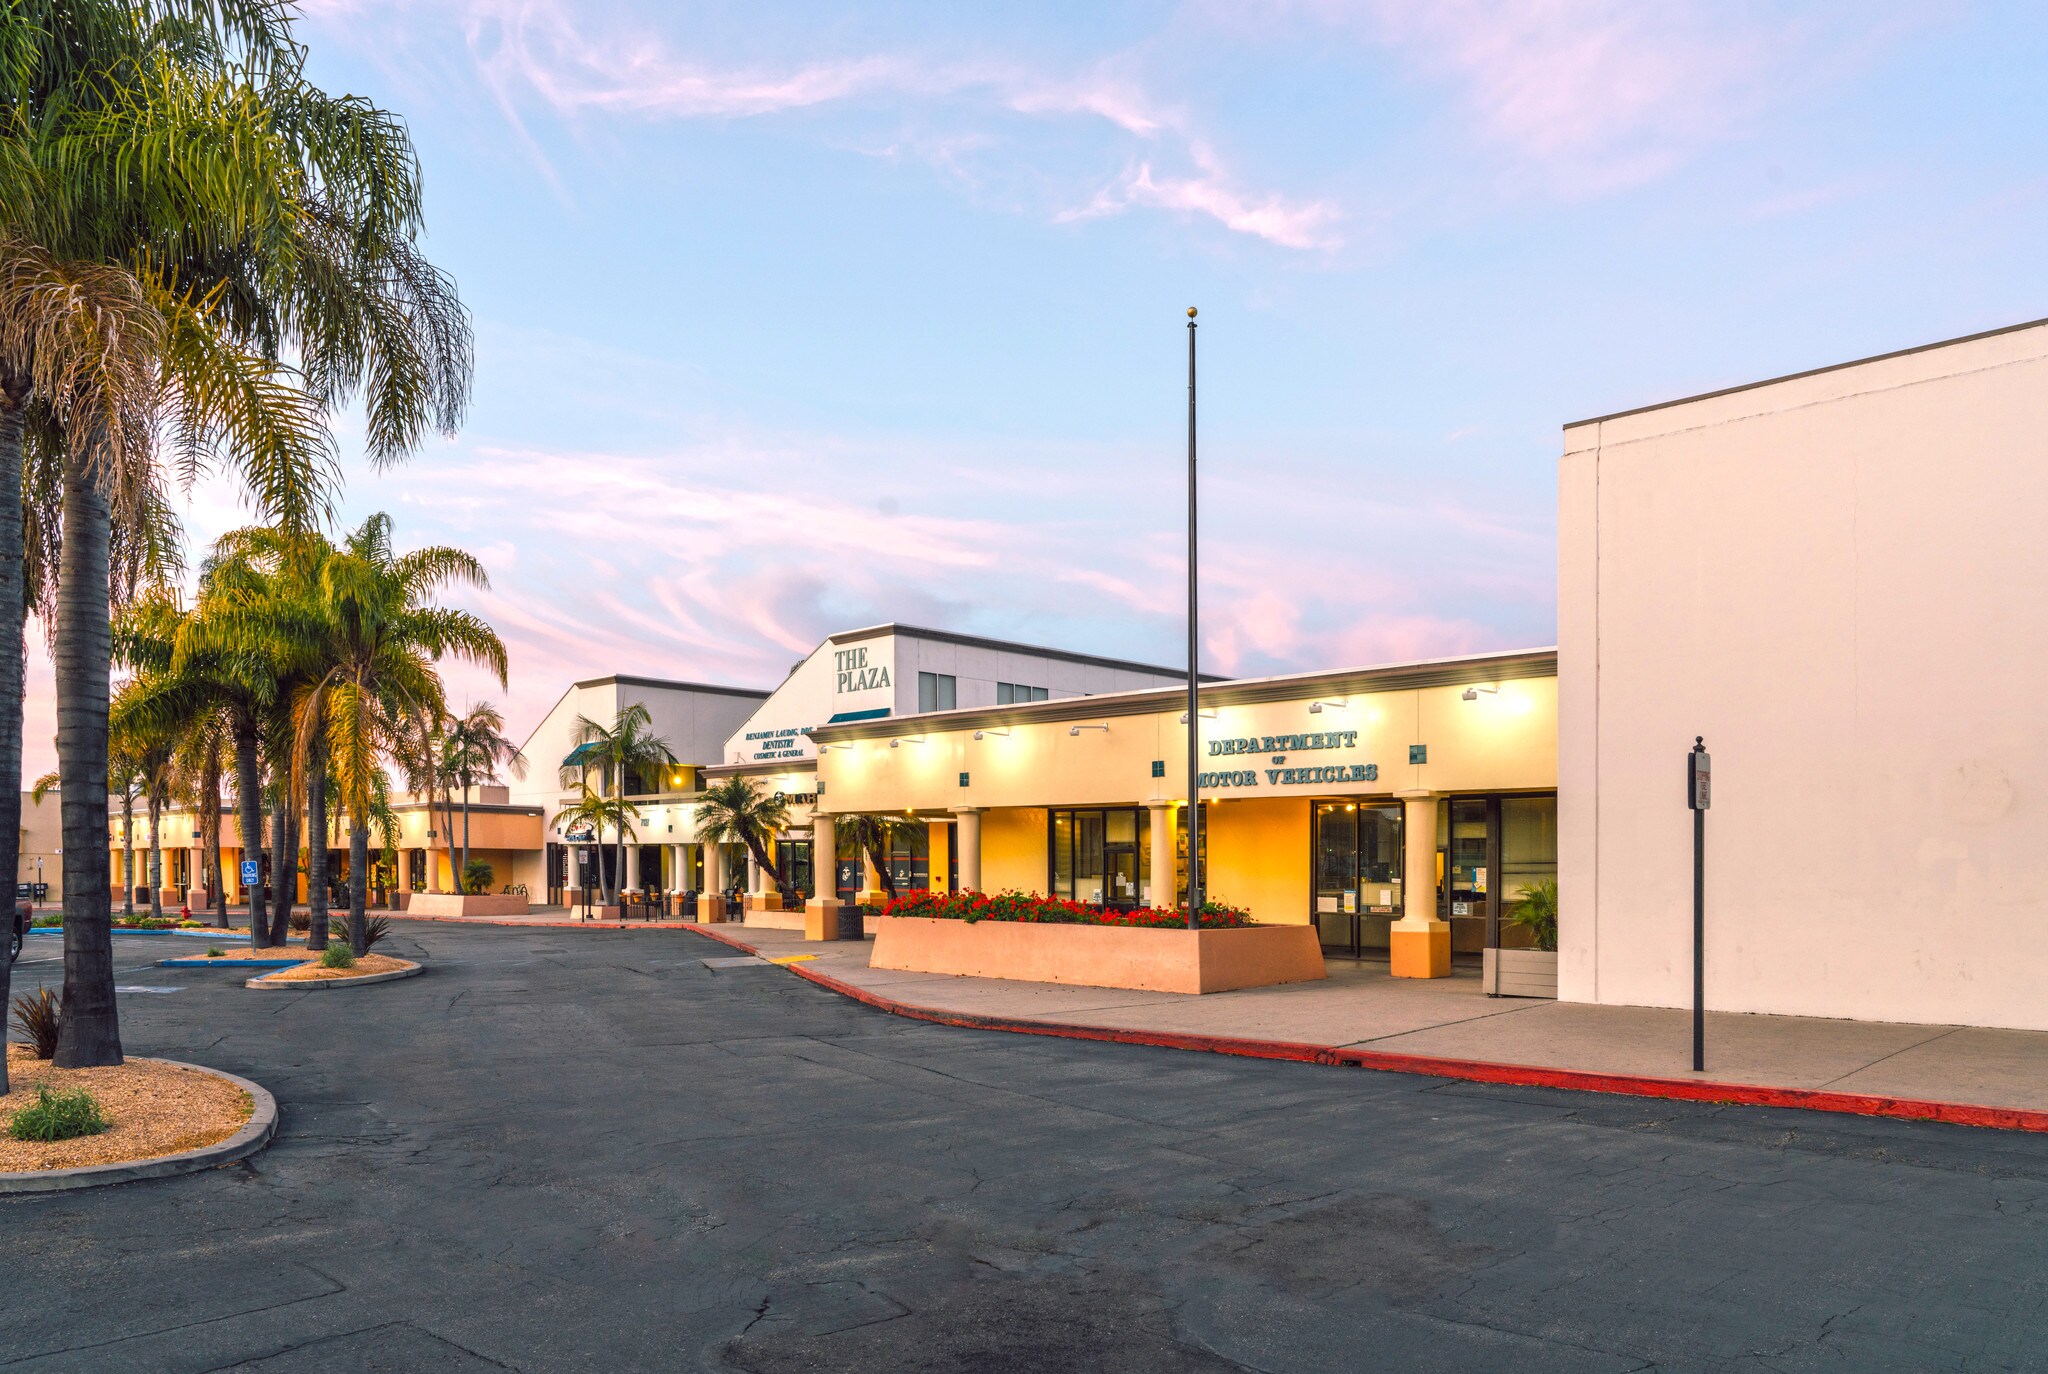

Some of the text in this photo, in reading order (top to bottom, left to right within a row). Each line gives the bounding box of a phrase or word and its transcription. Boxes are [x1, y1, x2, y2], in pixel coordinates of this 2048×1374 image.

[835, 647, 868, 672] THE
[837, 666, 891, 694] PLAZA
[746, 731, 775, 741] BENJAMIN
[1209, 731, 1357, 755] DEPARTMENT
[762, 739, 796, 750] DENTISTRY
[753, 749, 804, 760] COSMETIC & GENERAL
[1271, 755, 1286, 765] OF
[1265, 764, 1377, 785] VEHICLES
